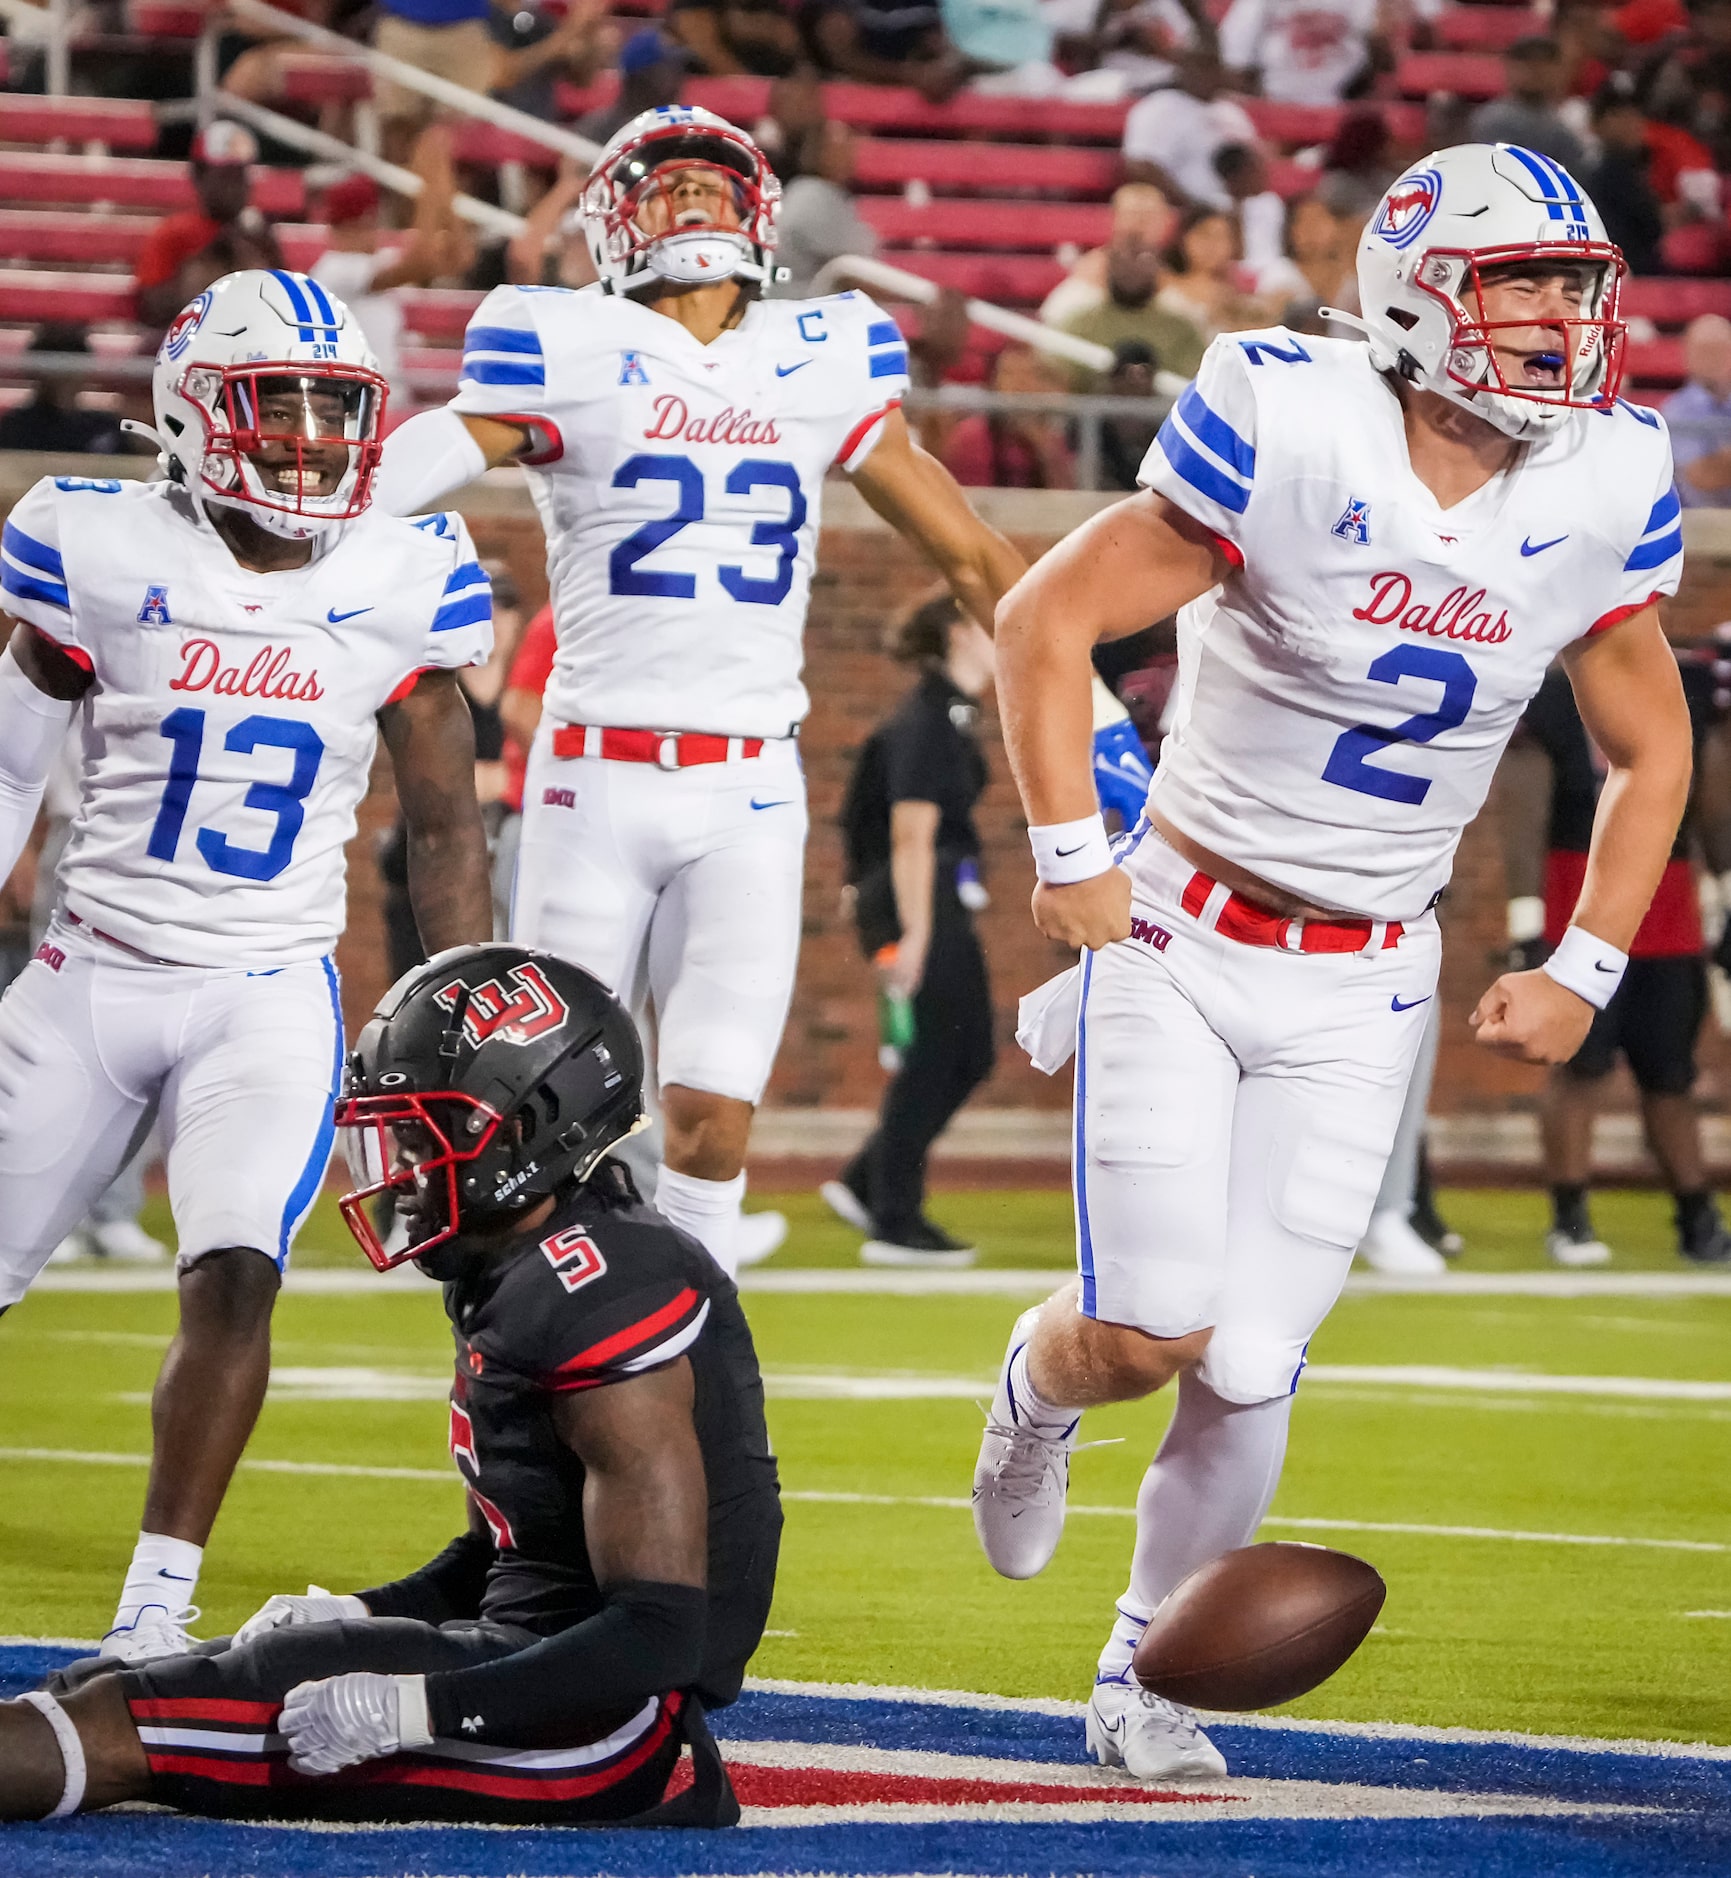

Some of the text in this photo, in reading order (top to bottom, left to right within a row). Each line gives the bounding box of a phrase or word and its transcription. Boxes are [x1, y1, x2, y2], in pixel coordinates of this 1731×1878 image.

[312, 343, 338, 359] 214
[796, 309, 828, 343] C
[1579, 314, 1603, 357] Ridde
[644, 395, 780, 445] Dallas
[609, 453, 808, 606] 23
[1332, 497, 1371, 546] A
[137, 585, 174, 626] A
[1352, 571, 1513, 645] Dallas
[169, 638, 325, 702] Dallas
[1321, 642, 1479, 805] 2
[146, 706, 327, 883] 13
[538, 1223, 608, 1294] 5
